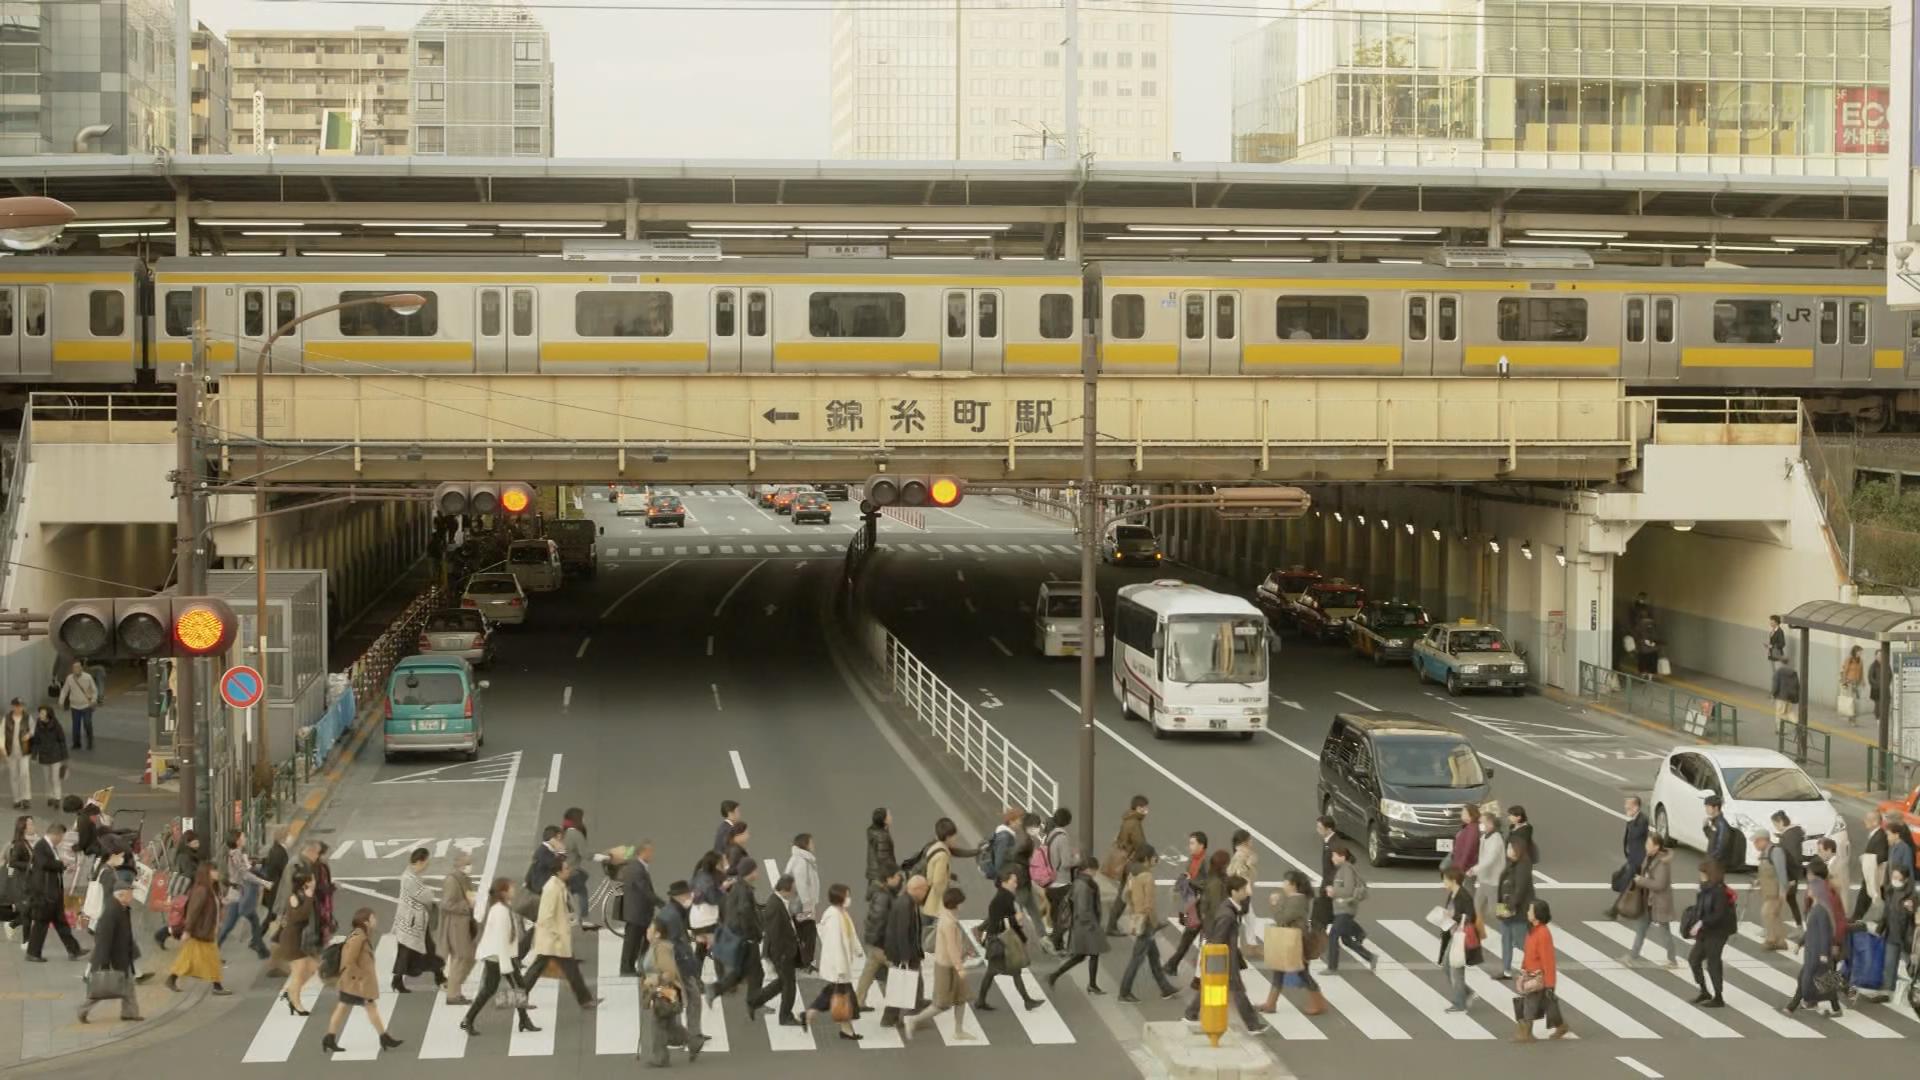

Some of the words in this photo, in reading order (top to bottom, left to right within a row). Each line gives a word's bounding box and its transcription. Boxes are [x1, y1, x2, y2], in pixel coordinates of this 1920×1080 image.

[1842, 102, 1890, 127] EC
[1786, 307, 1811, 322] JR
[825, 399, 1053, 434] 錦糸町駅
